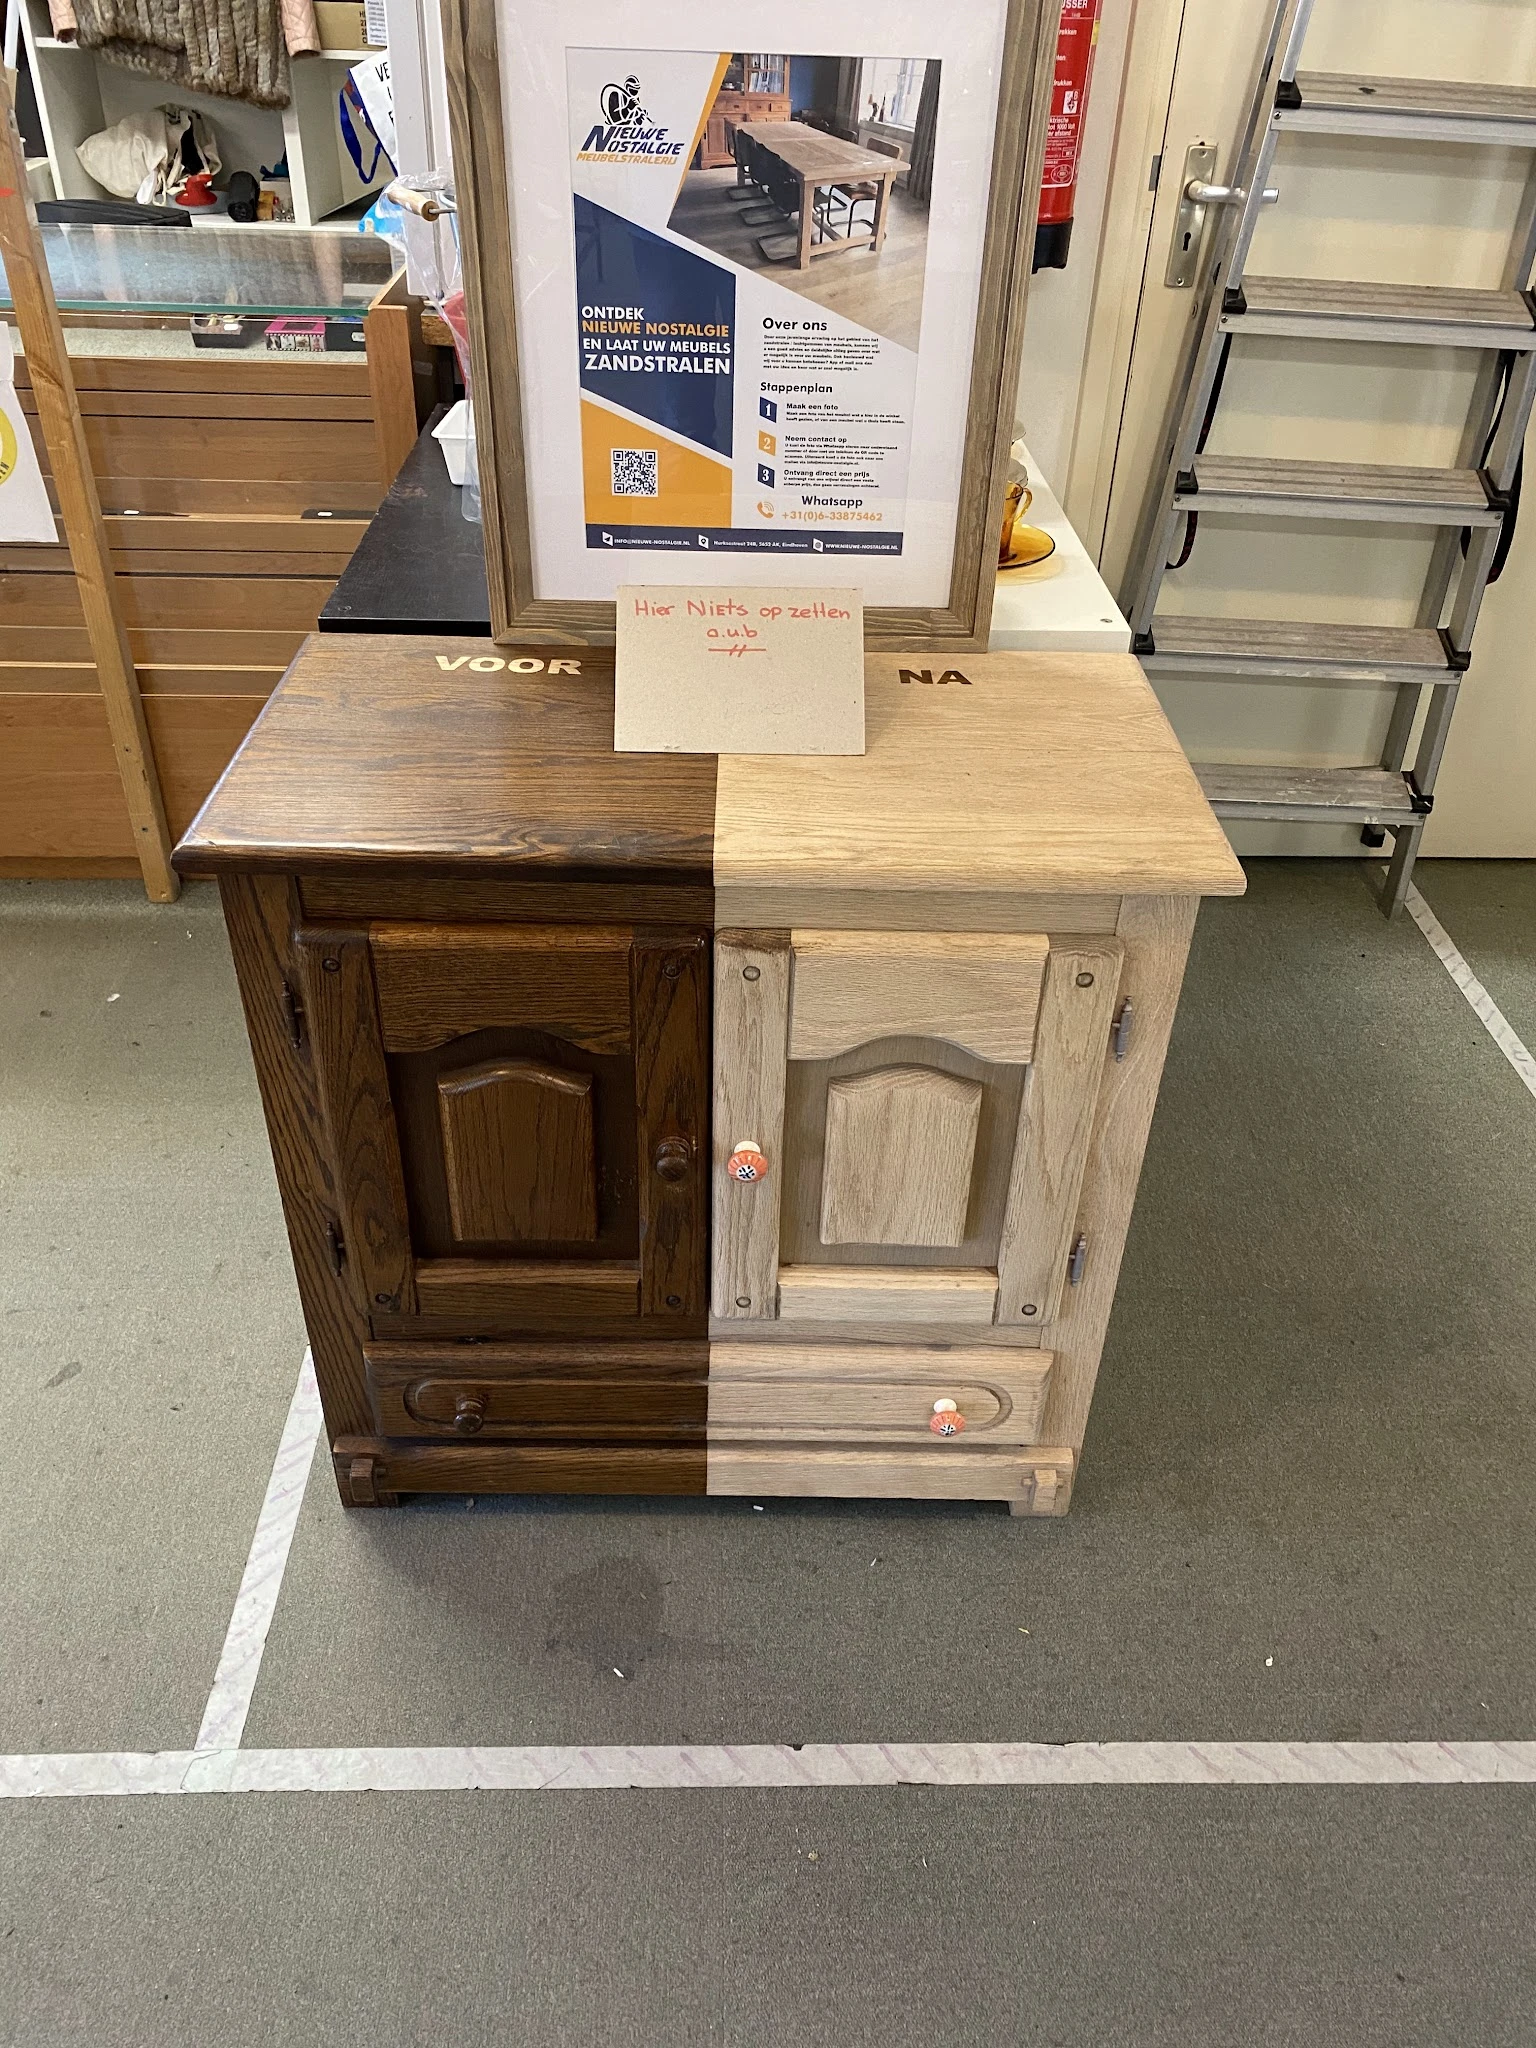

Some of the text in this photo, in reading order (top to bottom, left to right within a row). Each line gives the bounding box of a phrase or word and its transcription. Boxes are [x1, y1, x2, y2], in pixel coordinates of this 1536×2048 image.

[581, 126, 668, 152] NIEUWE
[576, 152, 678, 165] MEUBELSTRALERIJ
[581, 306, 644, 320] ONTDEK
[582, 320, 729, 337] NIEUWE NOSTALGIE
[762, 318, 828, 330] Over ons
[583, 338, 730, 354] EN LAAT UW MEUBELS
[584, 354, 730, 374] ZANDSTRALEN
[760, 382, 832, 394] Stappenplan
[766, 403, 770, 416] 1
[764, 438, 770, 450] 2
[762, 469, 769, 482] 3
[802, 496, 862, 508] Whatsapp
[782, 510, 883, 522] +31(0)6-33875462
[635, 598, 675, 616] Hier
[760, 606, 782, 620] op
[788, 602, 850, 620] zetten
[434, 656, 972, 685] VOOR NA
